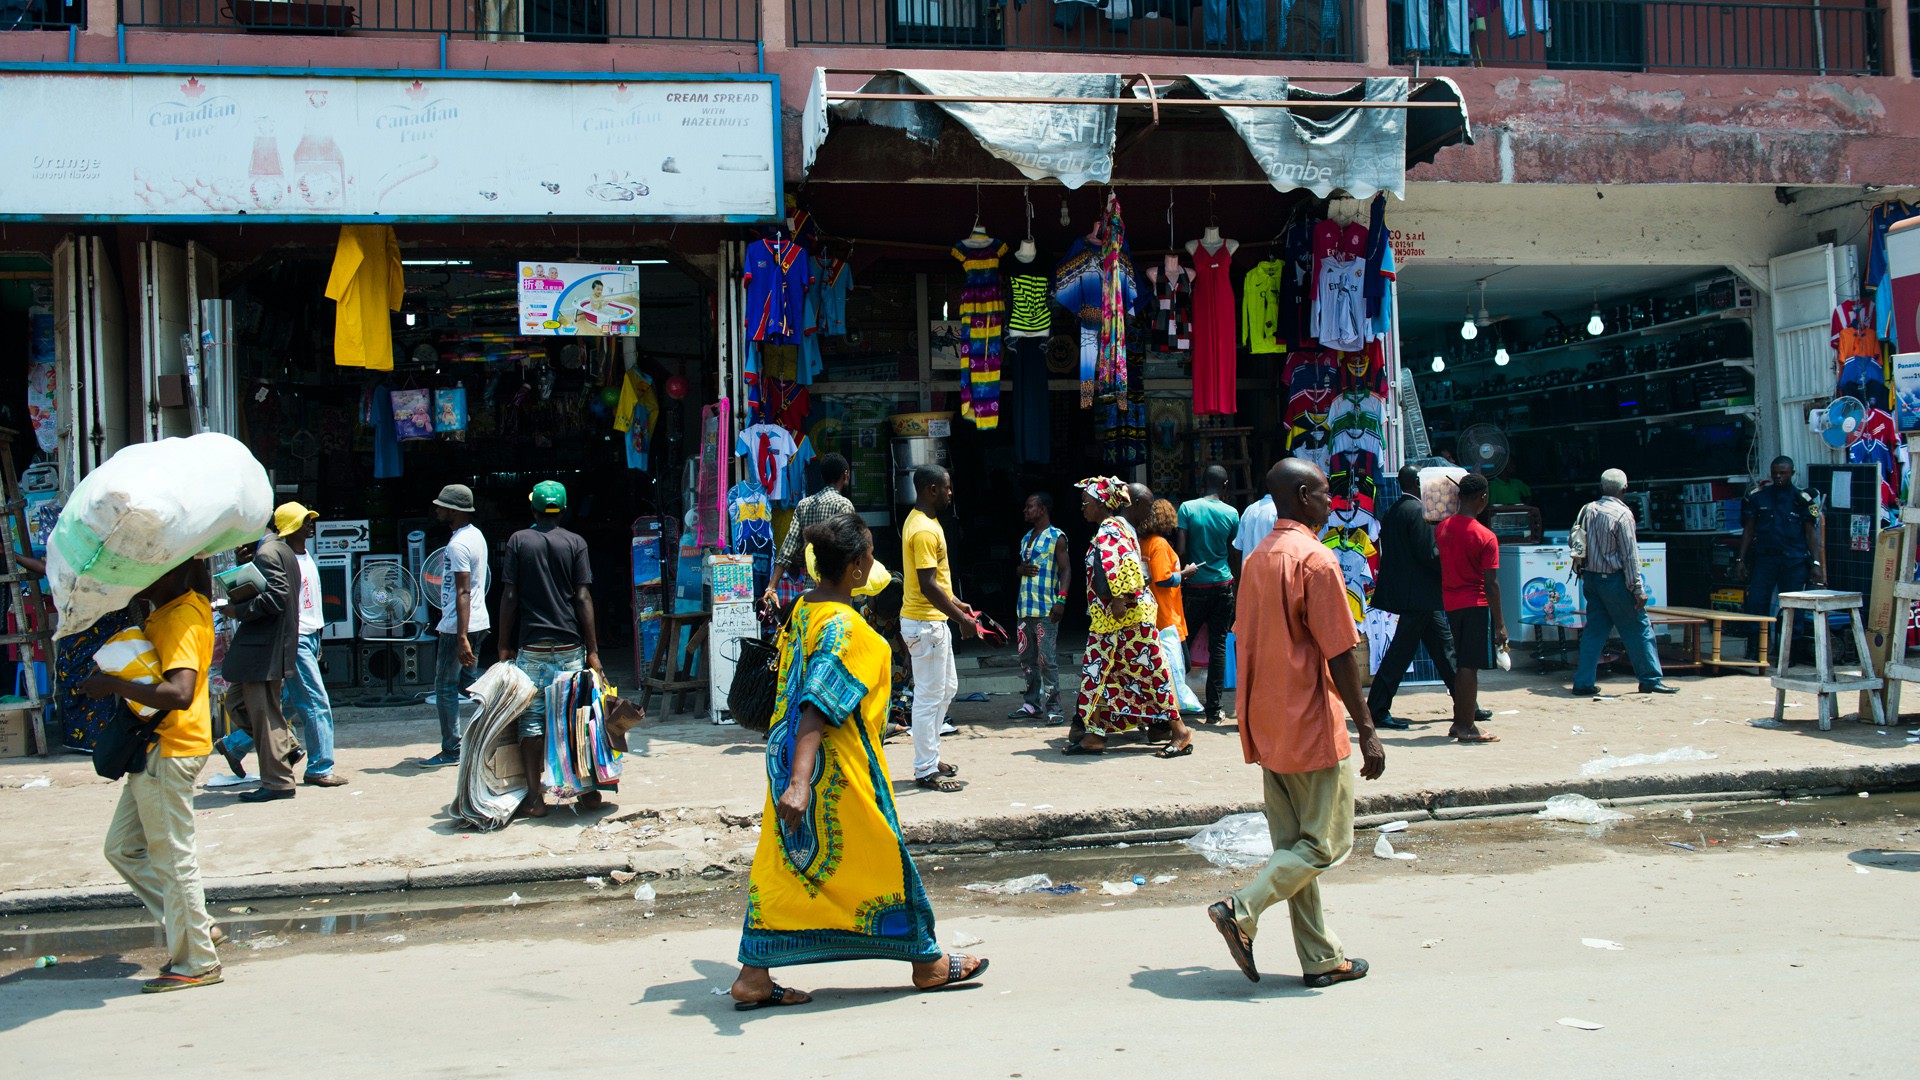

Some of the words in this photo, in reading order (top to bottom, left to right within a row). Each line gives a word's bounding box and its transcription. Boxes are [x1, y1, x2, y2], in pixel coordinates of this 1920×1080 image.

[666, 93, 709, 103] CREAM
[712, 94, 760, 104] SPREAD
[149, 104, 236, 128] Canadian
[376, 107, 459, 130] Canadian
[682, 116, 750, 127] HAZELNUTS
[702, 107, 726, 116] WITH
[32, 154, 102, 172] Orange
[1056, 151, 1084, 173] du
[1258, 154, 1333, 182] Gombe
